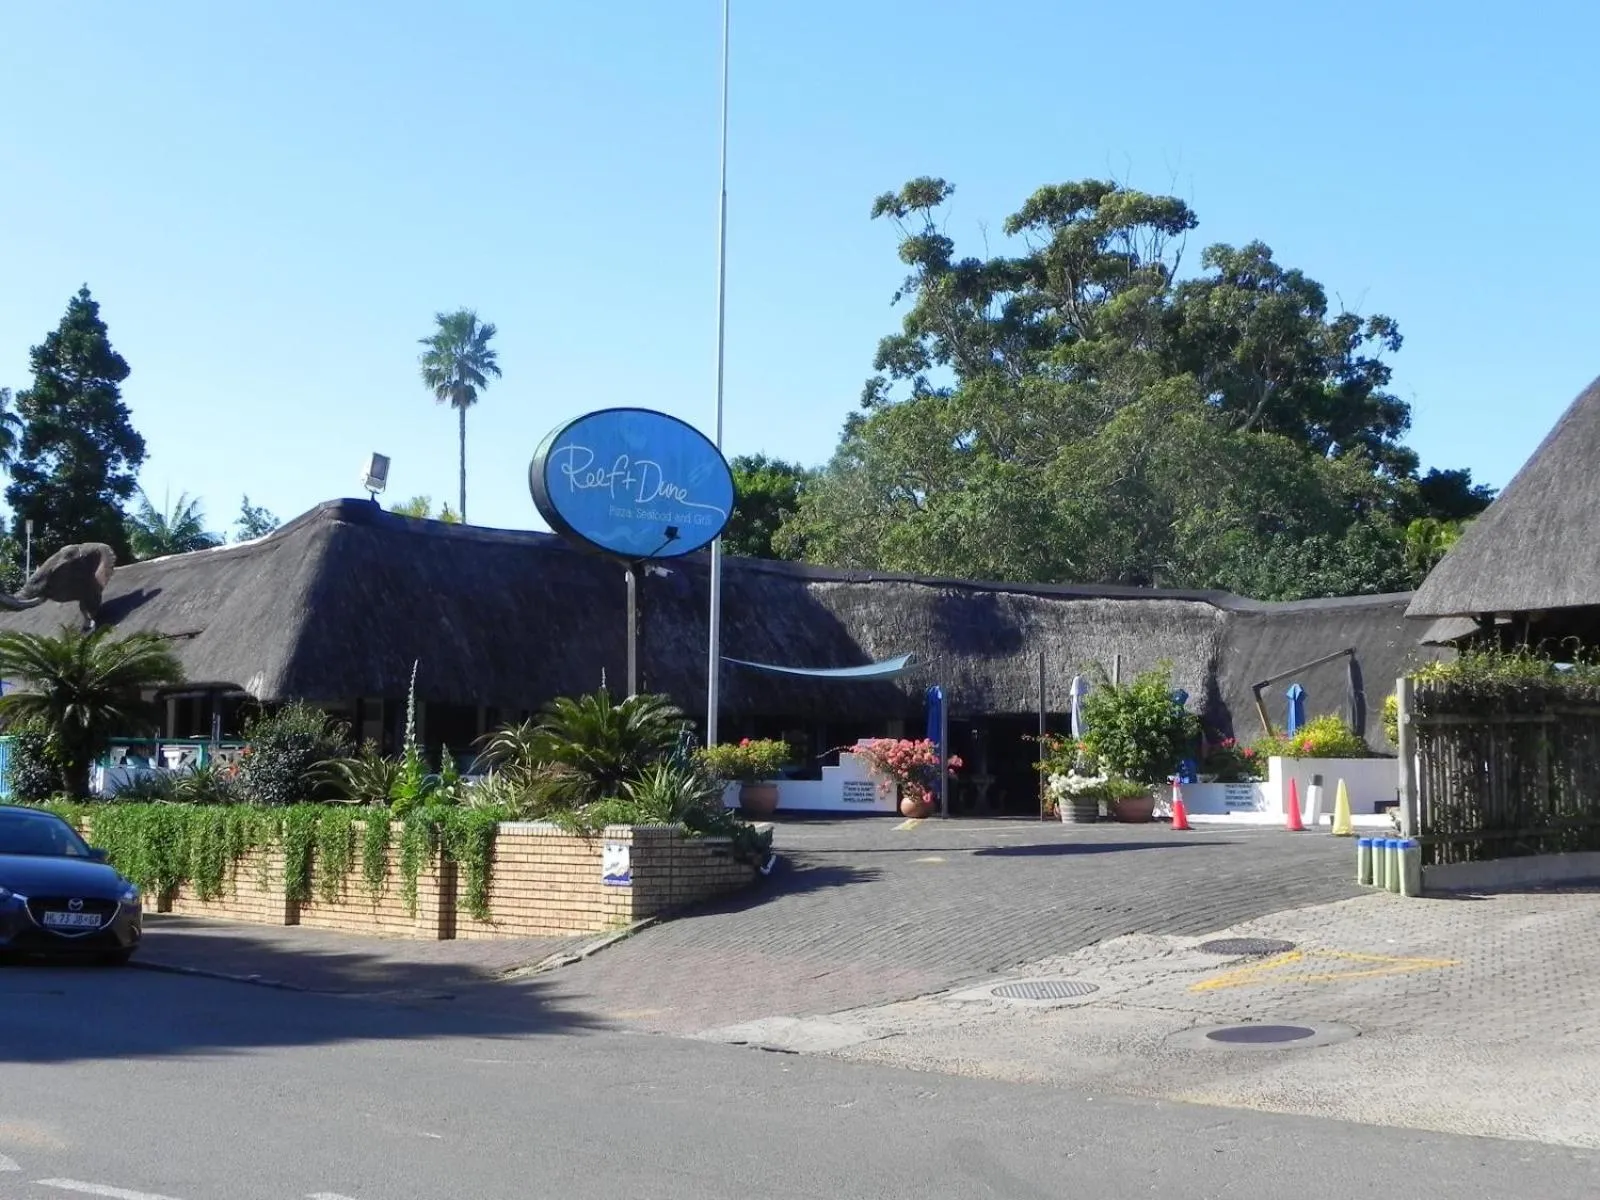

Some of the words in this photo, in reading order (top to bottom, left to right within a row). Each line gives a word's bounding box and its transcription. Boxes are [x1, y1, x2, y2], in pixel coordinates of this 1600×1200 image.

[549, 443, 629, 499] Reef
[634, 460, 726, 519] Dune
[636, 508, 672, 522] Seafood
